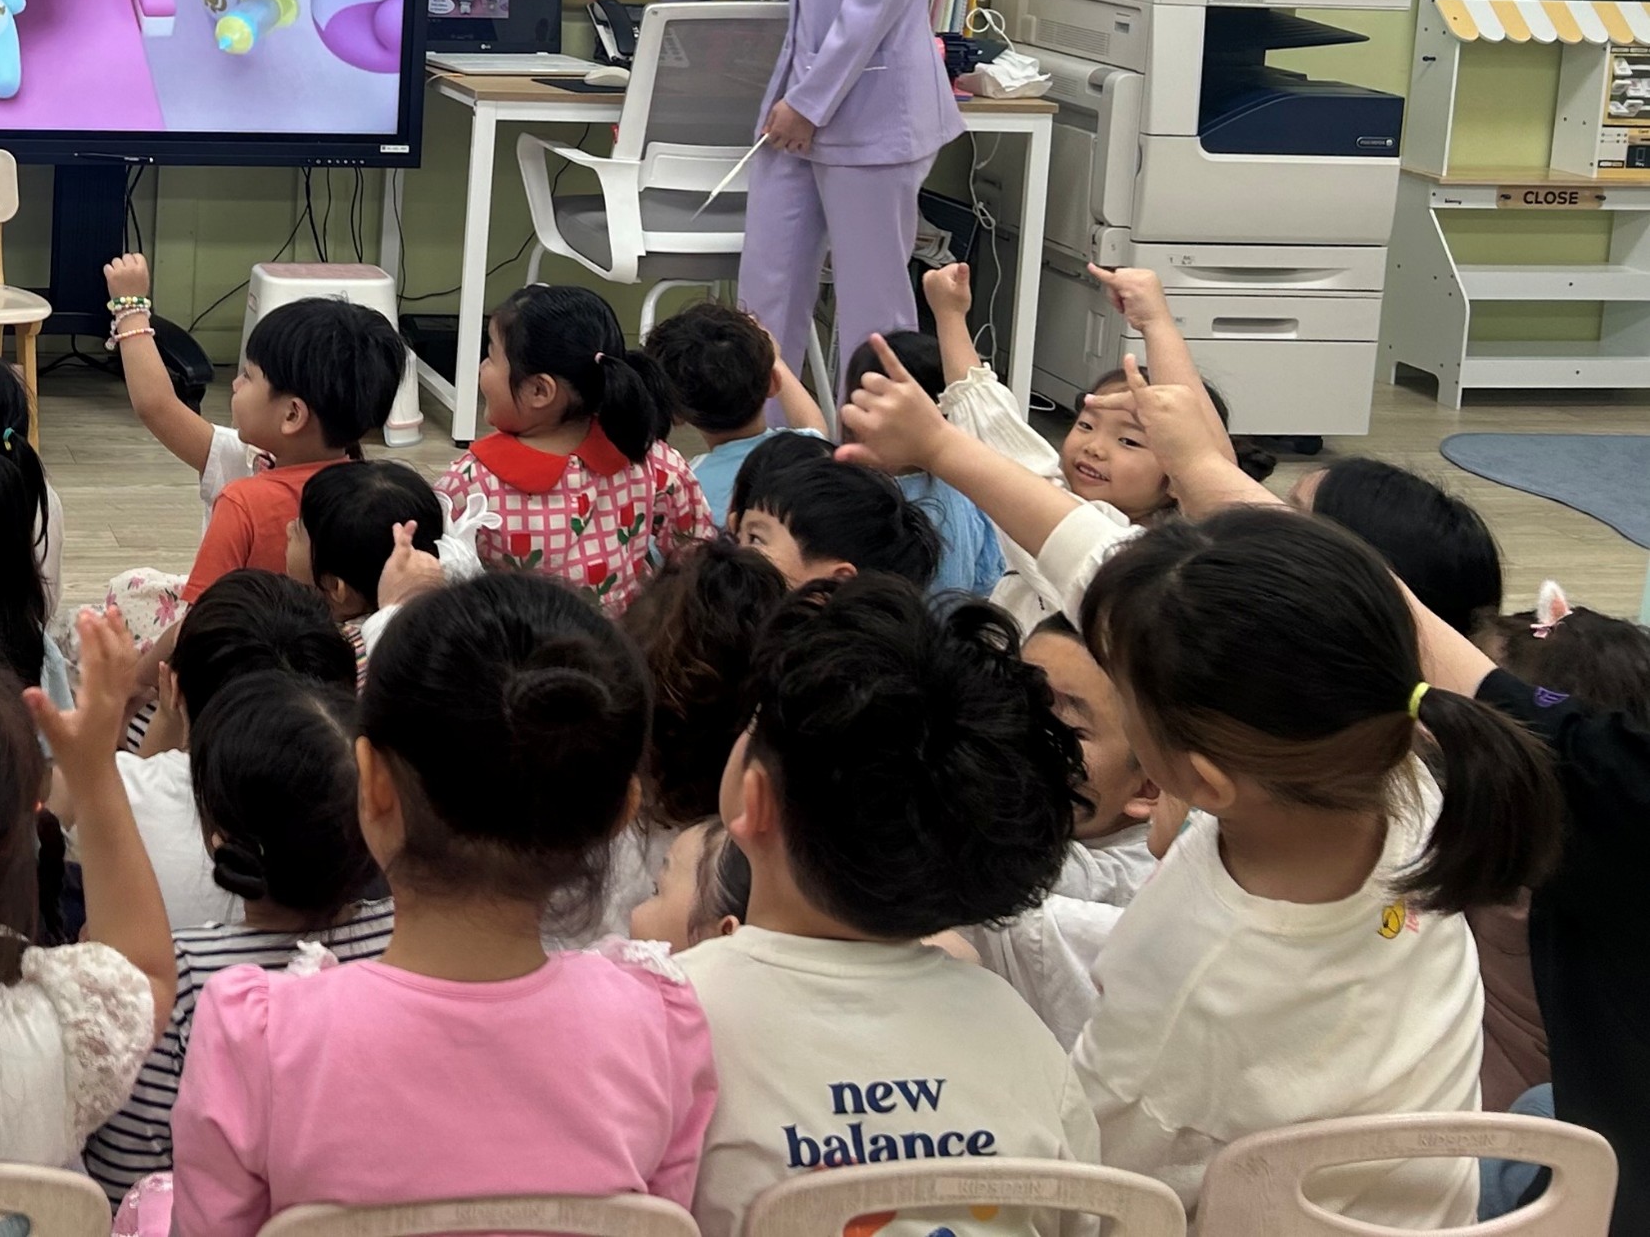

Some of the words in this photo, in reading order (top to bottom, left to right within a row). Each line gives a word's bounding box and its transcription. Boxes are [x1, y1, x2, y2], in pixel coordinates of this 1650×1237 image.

[1523, 191, 1579, 205] CLOSE
[828, 1078, 947, 1115] new
[781, 1121, 998, 1169] balance
